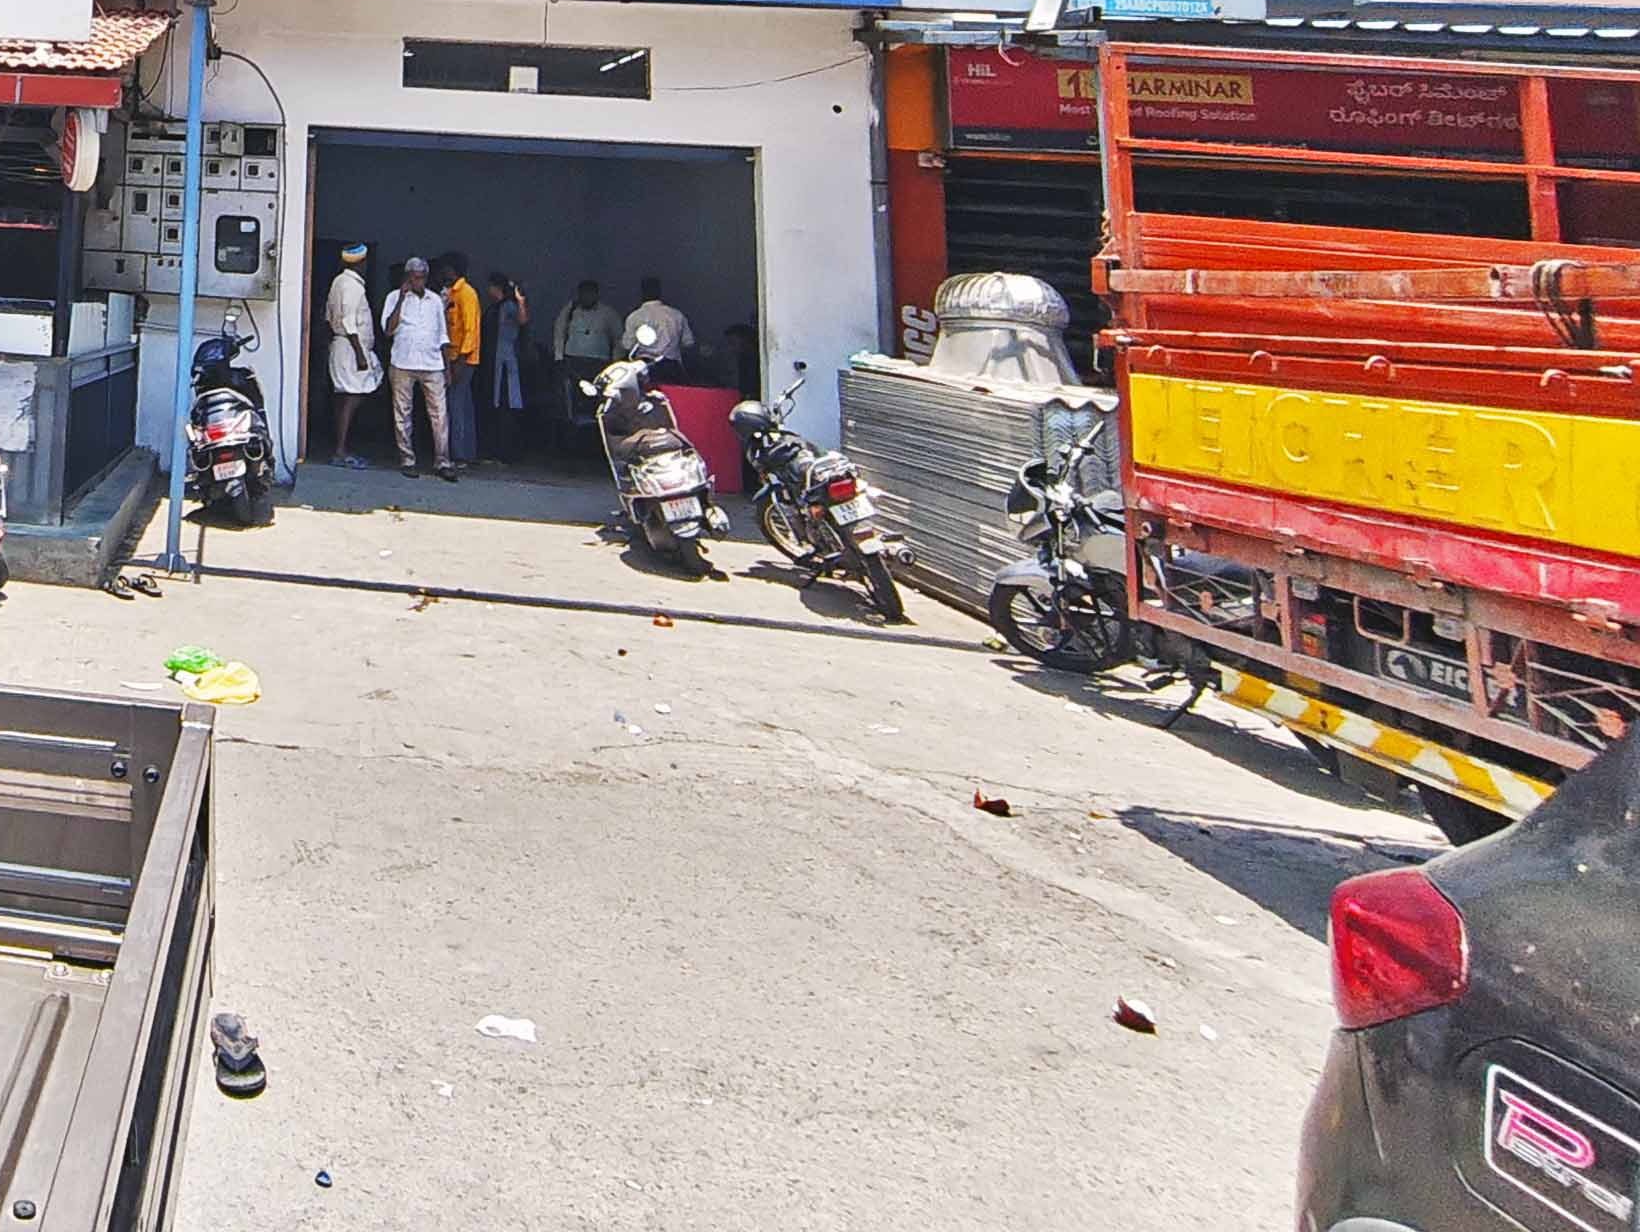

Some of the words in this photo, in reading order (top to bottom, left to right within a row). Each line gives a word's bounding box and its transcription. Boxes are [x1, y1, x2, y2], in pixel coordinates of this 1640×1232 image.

[1127, 76, 1242, 99] HARMINAR
[1146, 106, 1197, 121] Roofing
[1200, 108, 1256, 122] Solution
[1184, 383, 1557, 532] EICHER
